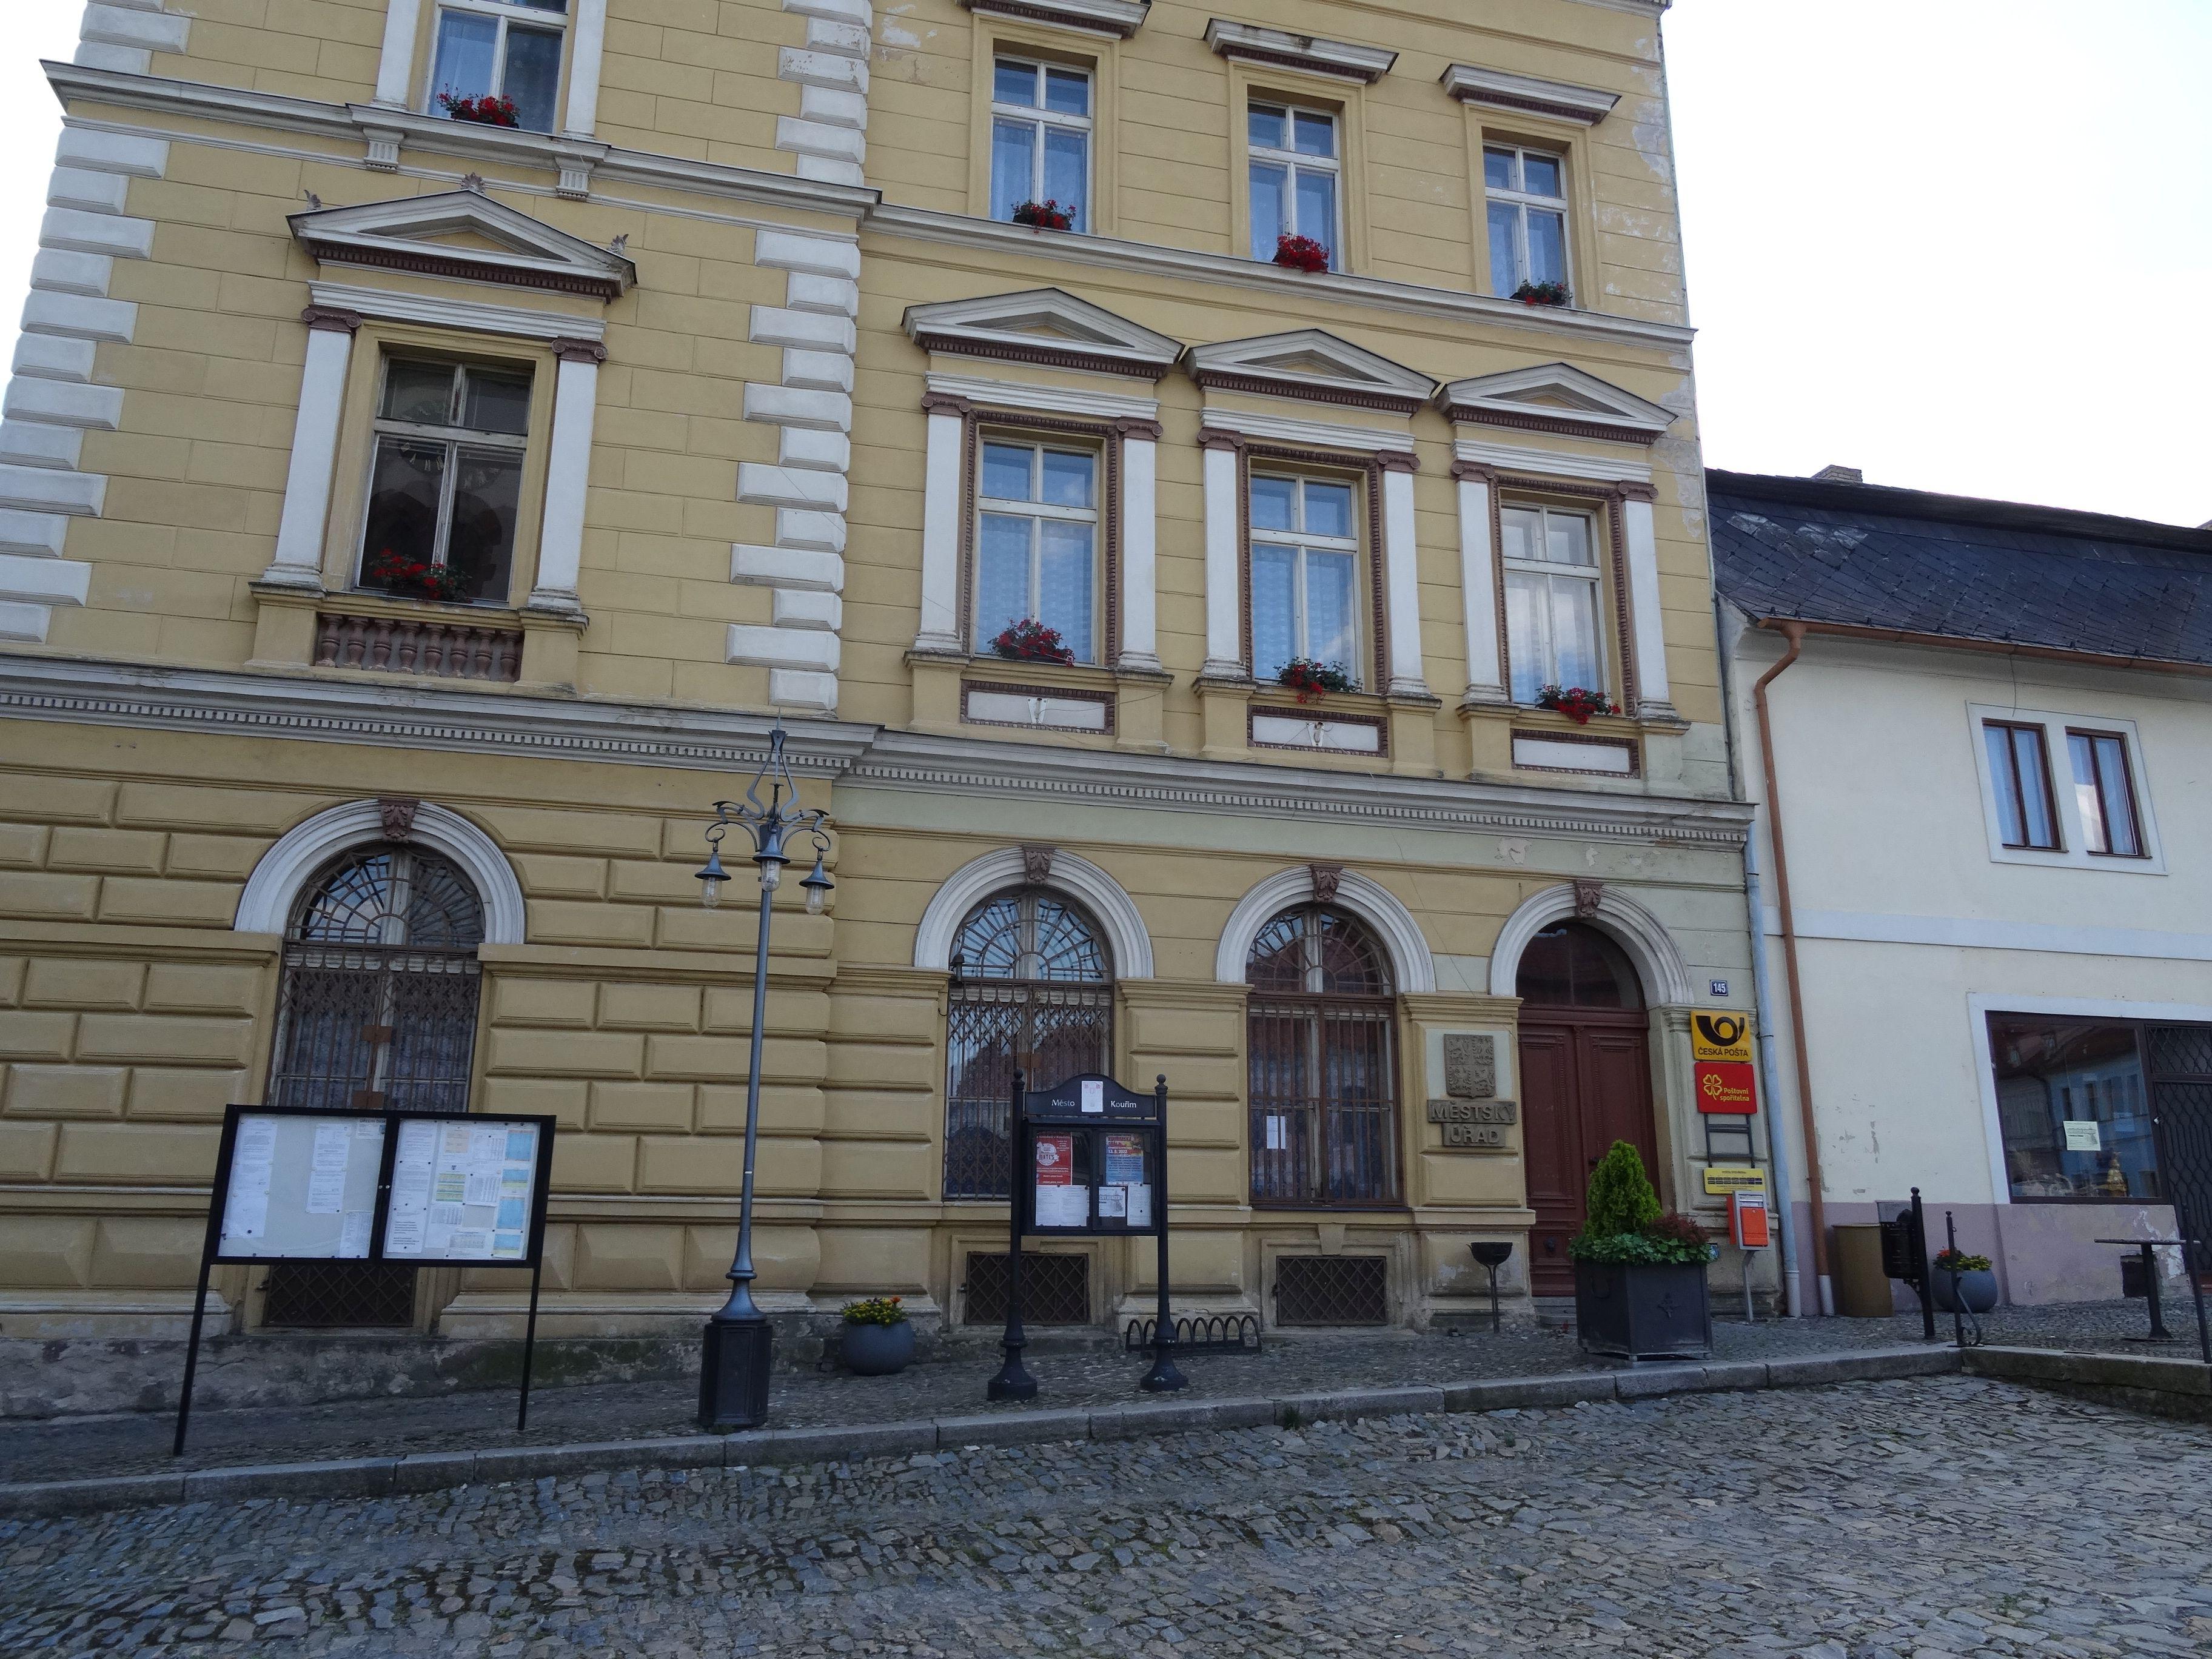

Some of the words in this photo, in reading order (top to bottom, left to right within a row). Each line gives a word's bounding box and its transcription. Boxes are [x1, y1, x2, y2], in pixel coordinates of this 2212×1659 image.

[1713, 982, 1726, 993] 145
[1698, 1047, 1723, 1056] ČESKÁ
[1724, 1047, 1748, 1056] POŠTA
[1430, 1101, 1515, 1121] MĚSTSKÝ
[1450, 1125, 1501, 1144] ÚŘAD
